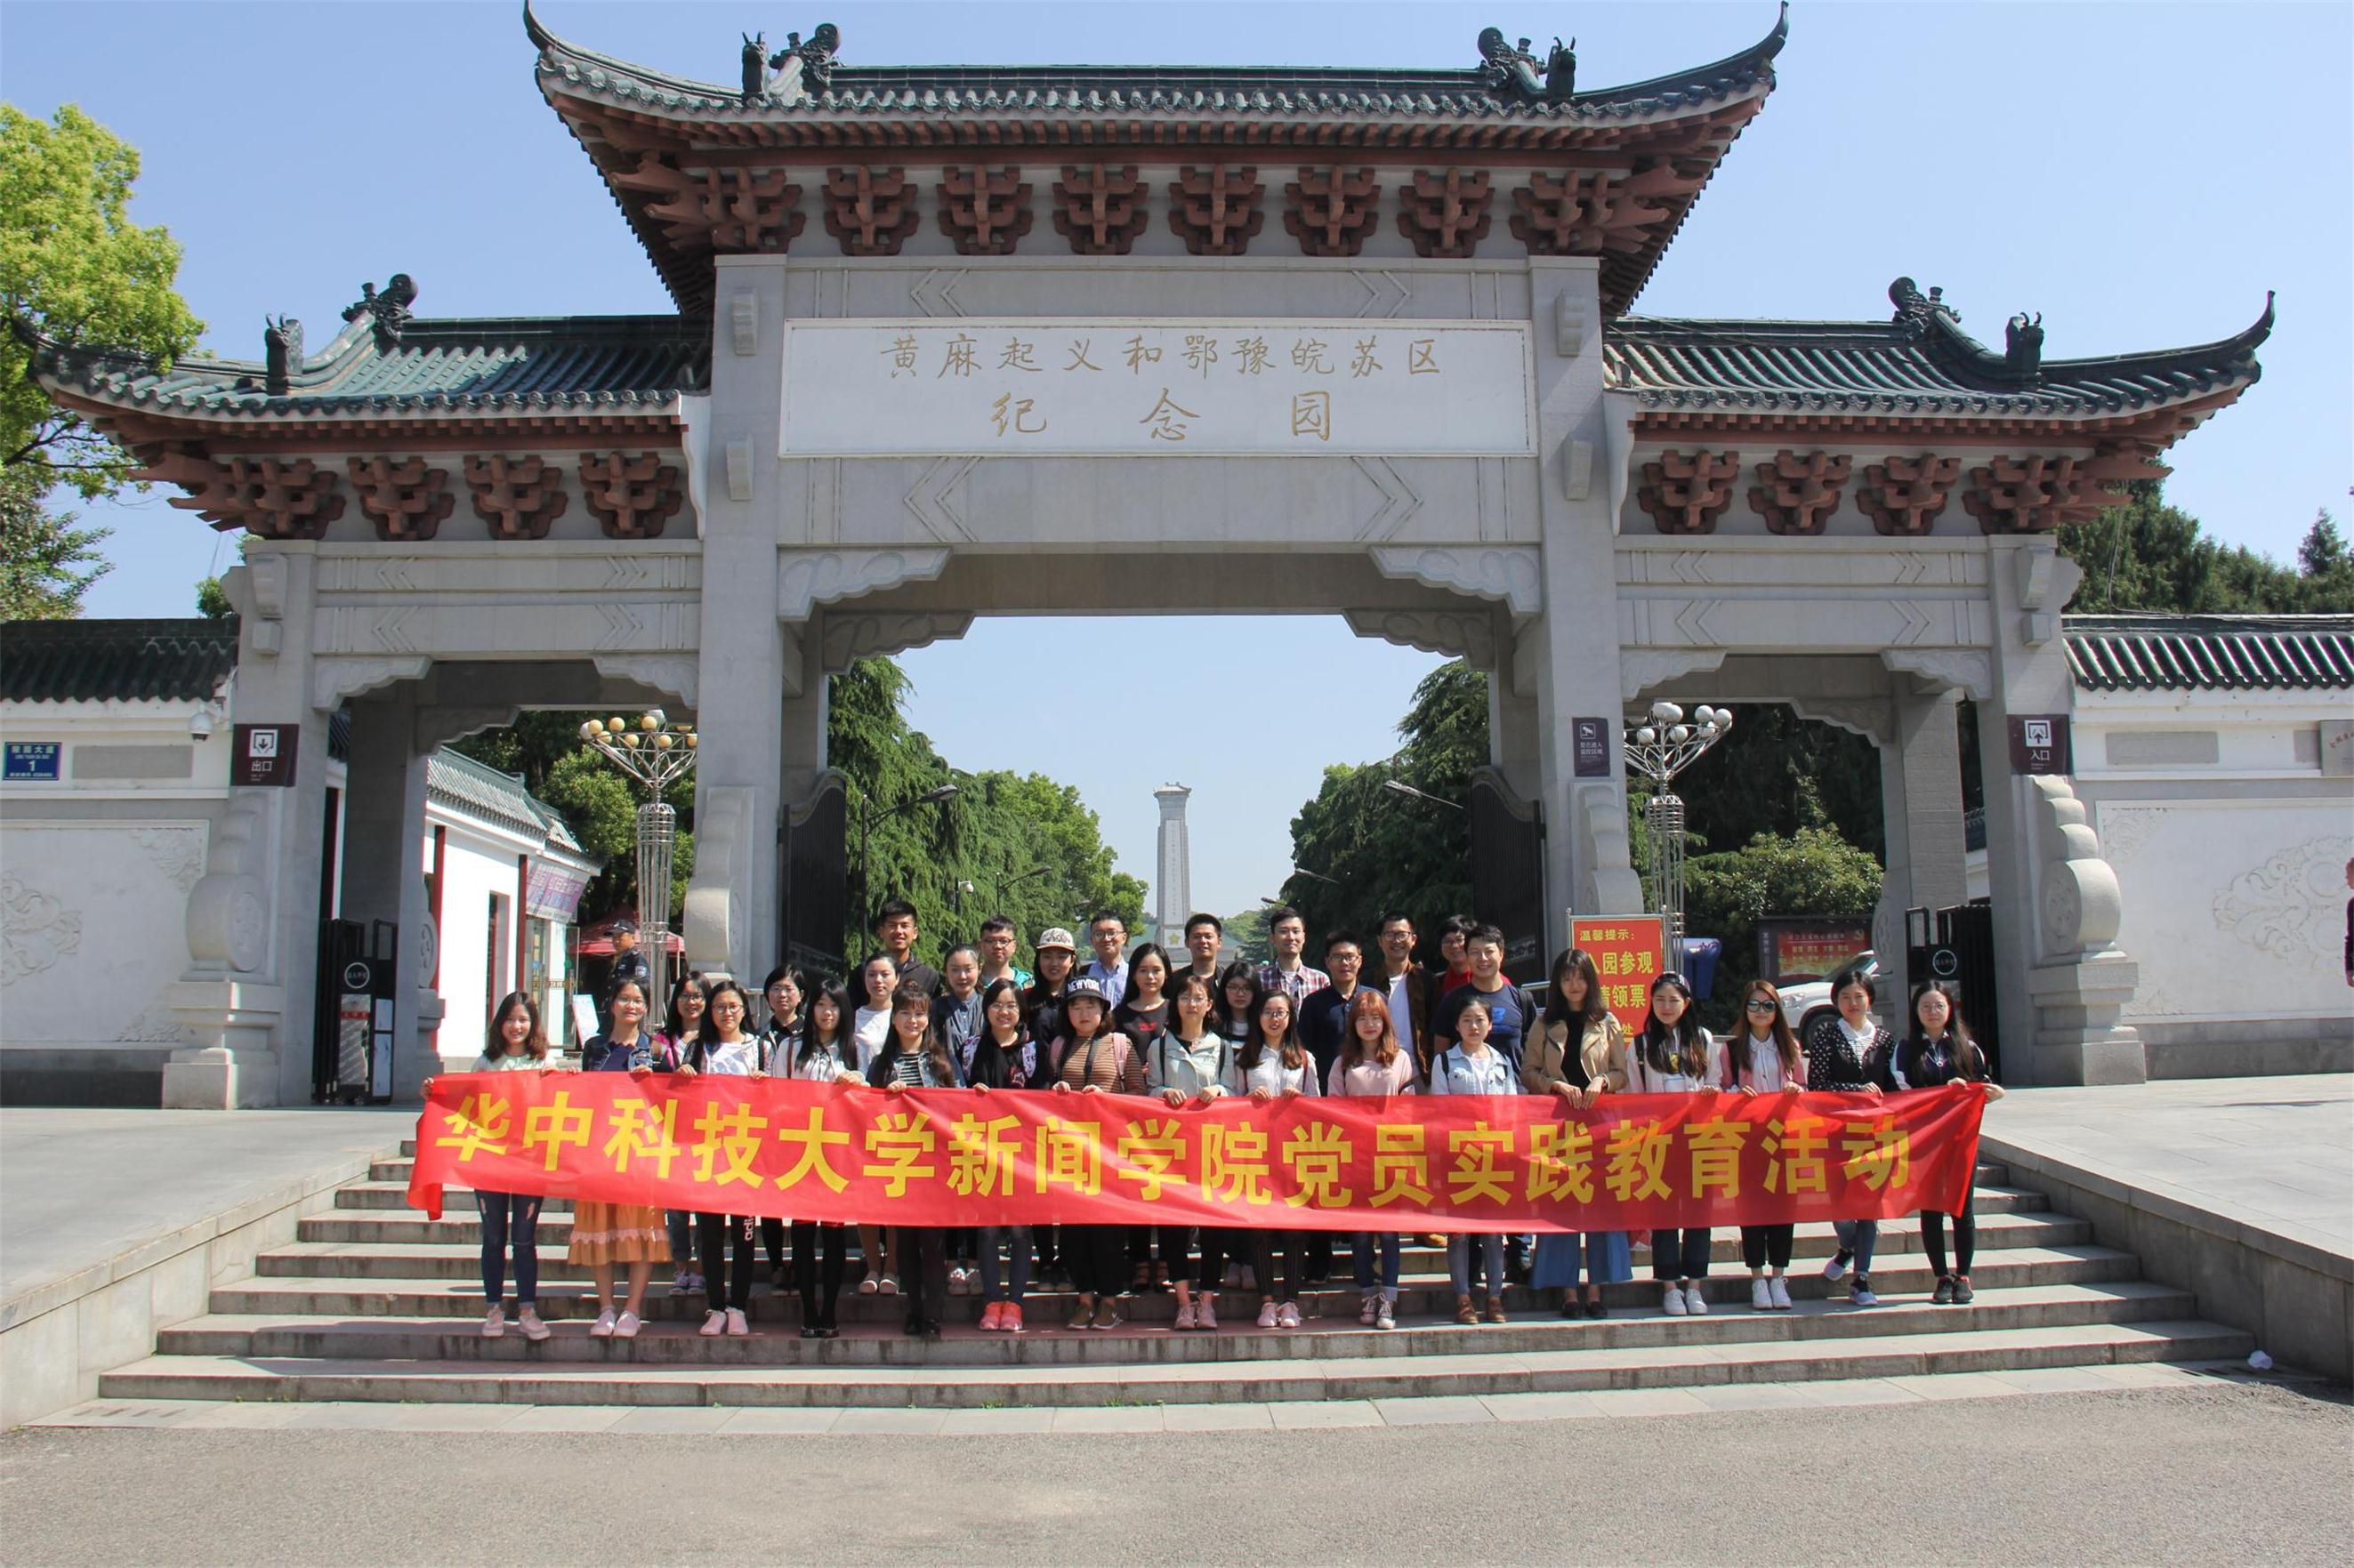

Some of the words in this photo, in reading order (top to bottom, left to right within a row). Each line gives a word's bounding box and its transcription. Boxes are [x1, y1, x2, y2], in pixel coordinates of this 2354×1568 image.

[881, 334, 1439, 380] 黄麻起义和鄂豫皖苏区
[991, 388, 1331, 442] 纪念园
[28, 760, 36, 771] 1
[251, 760, 272, 771] 出口
[2031, 750, 2050, 760] 入口
[438, 1092, 1909, 1207] 华中科技大学新闻学院党员实践教育活动
